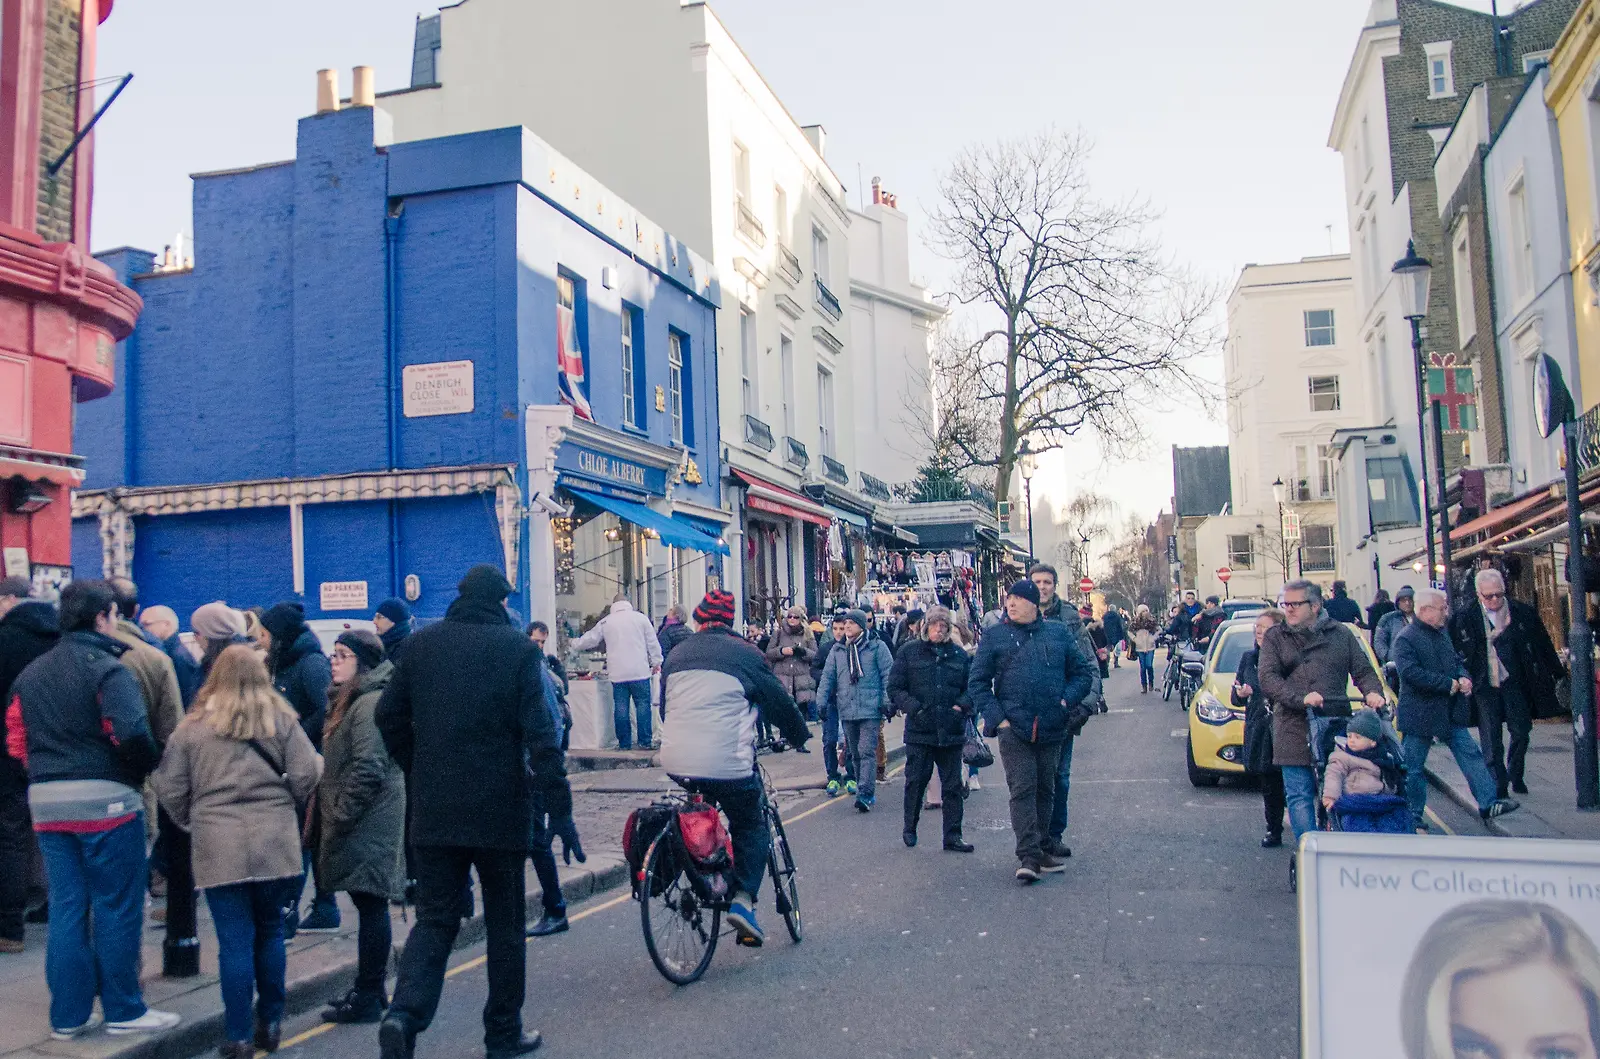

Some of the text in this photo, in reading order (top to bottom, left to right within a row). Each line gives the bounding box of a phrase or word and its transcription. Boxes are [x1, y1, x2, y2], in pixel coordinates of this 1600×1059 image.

[415, 378, 461, 390] DENBIGH
[410, 390, 441, 401] CLOSE
[579, 451, 609, 476] CHLOE
[612, 460, 646, 486] ALBERRY
[1339, 867, 1400, 891] New
[1411, 869, 1557, 898] Collection
